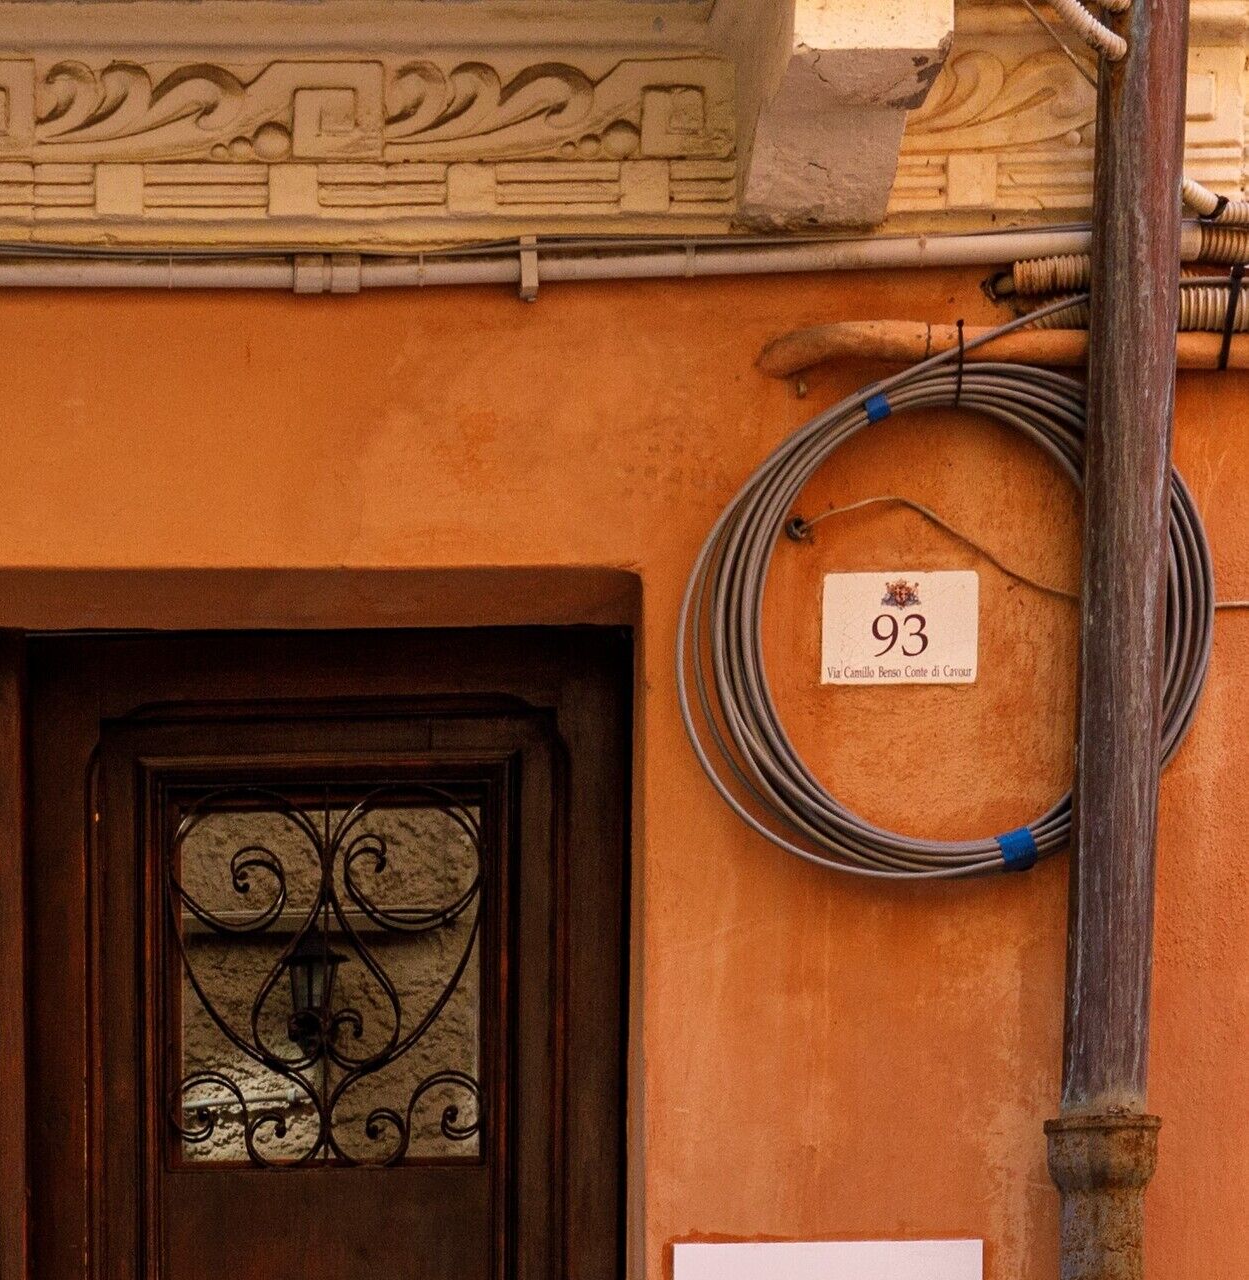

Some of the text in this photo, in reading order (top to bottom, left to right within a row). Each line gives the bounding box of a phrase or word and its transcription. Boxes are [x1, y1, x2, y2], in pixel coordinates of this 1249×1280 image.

[871, 613, 929, 658] 93
[827, 665, 973, 678] Via Camillo Benso Conte di Cavour
